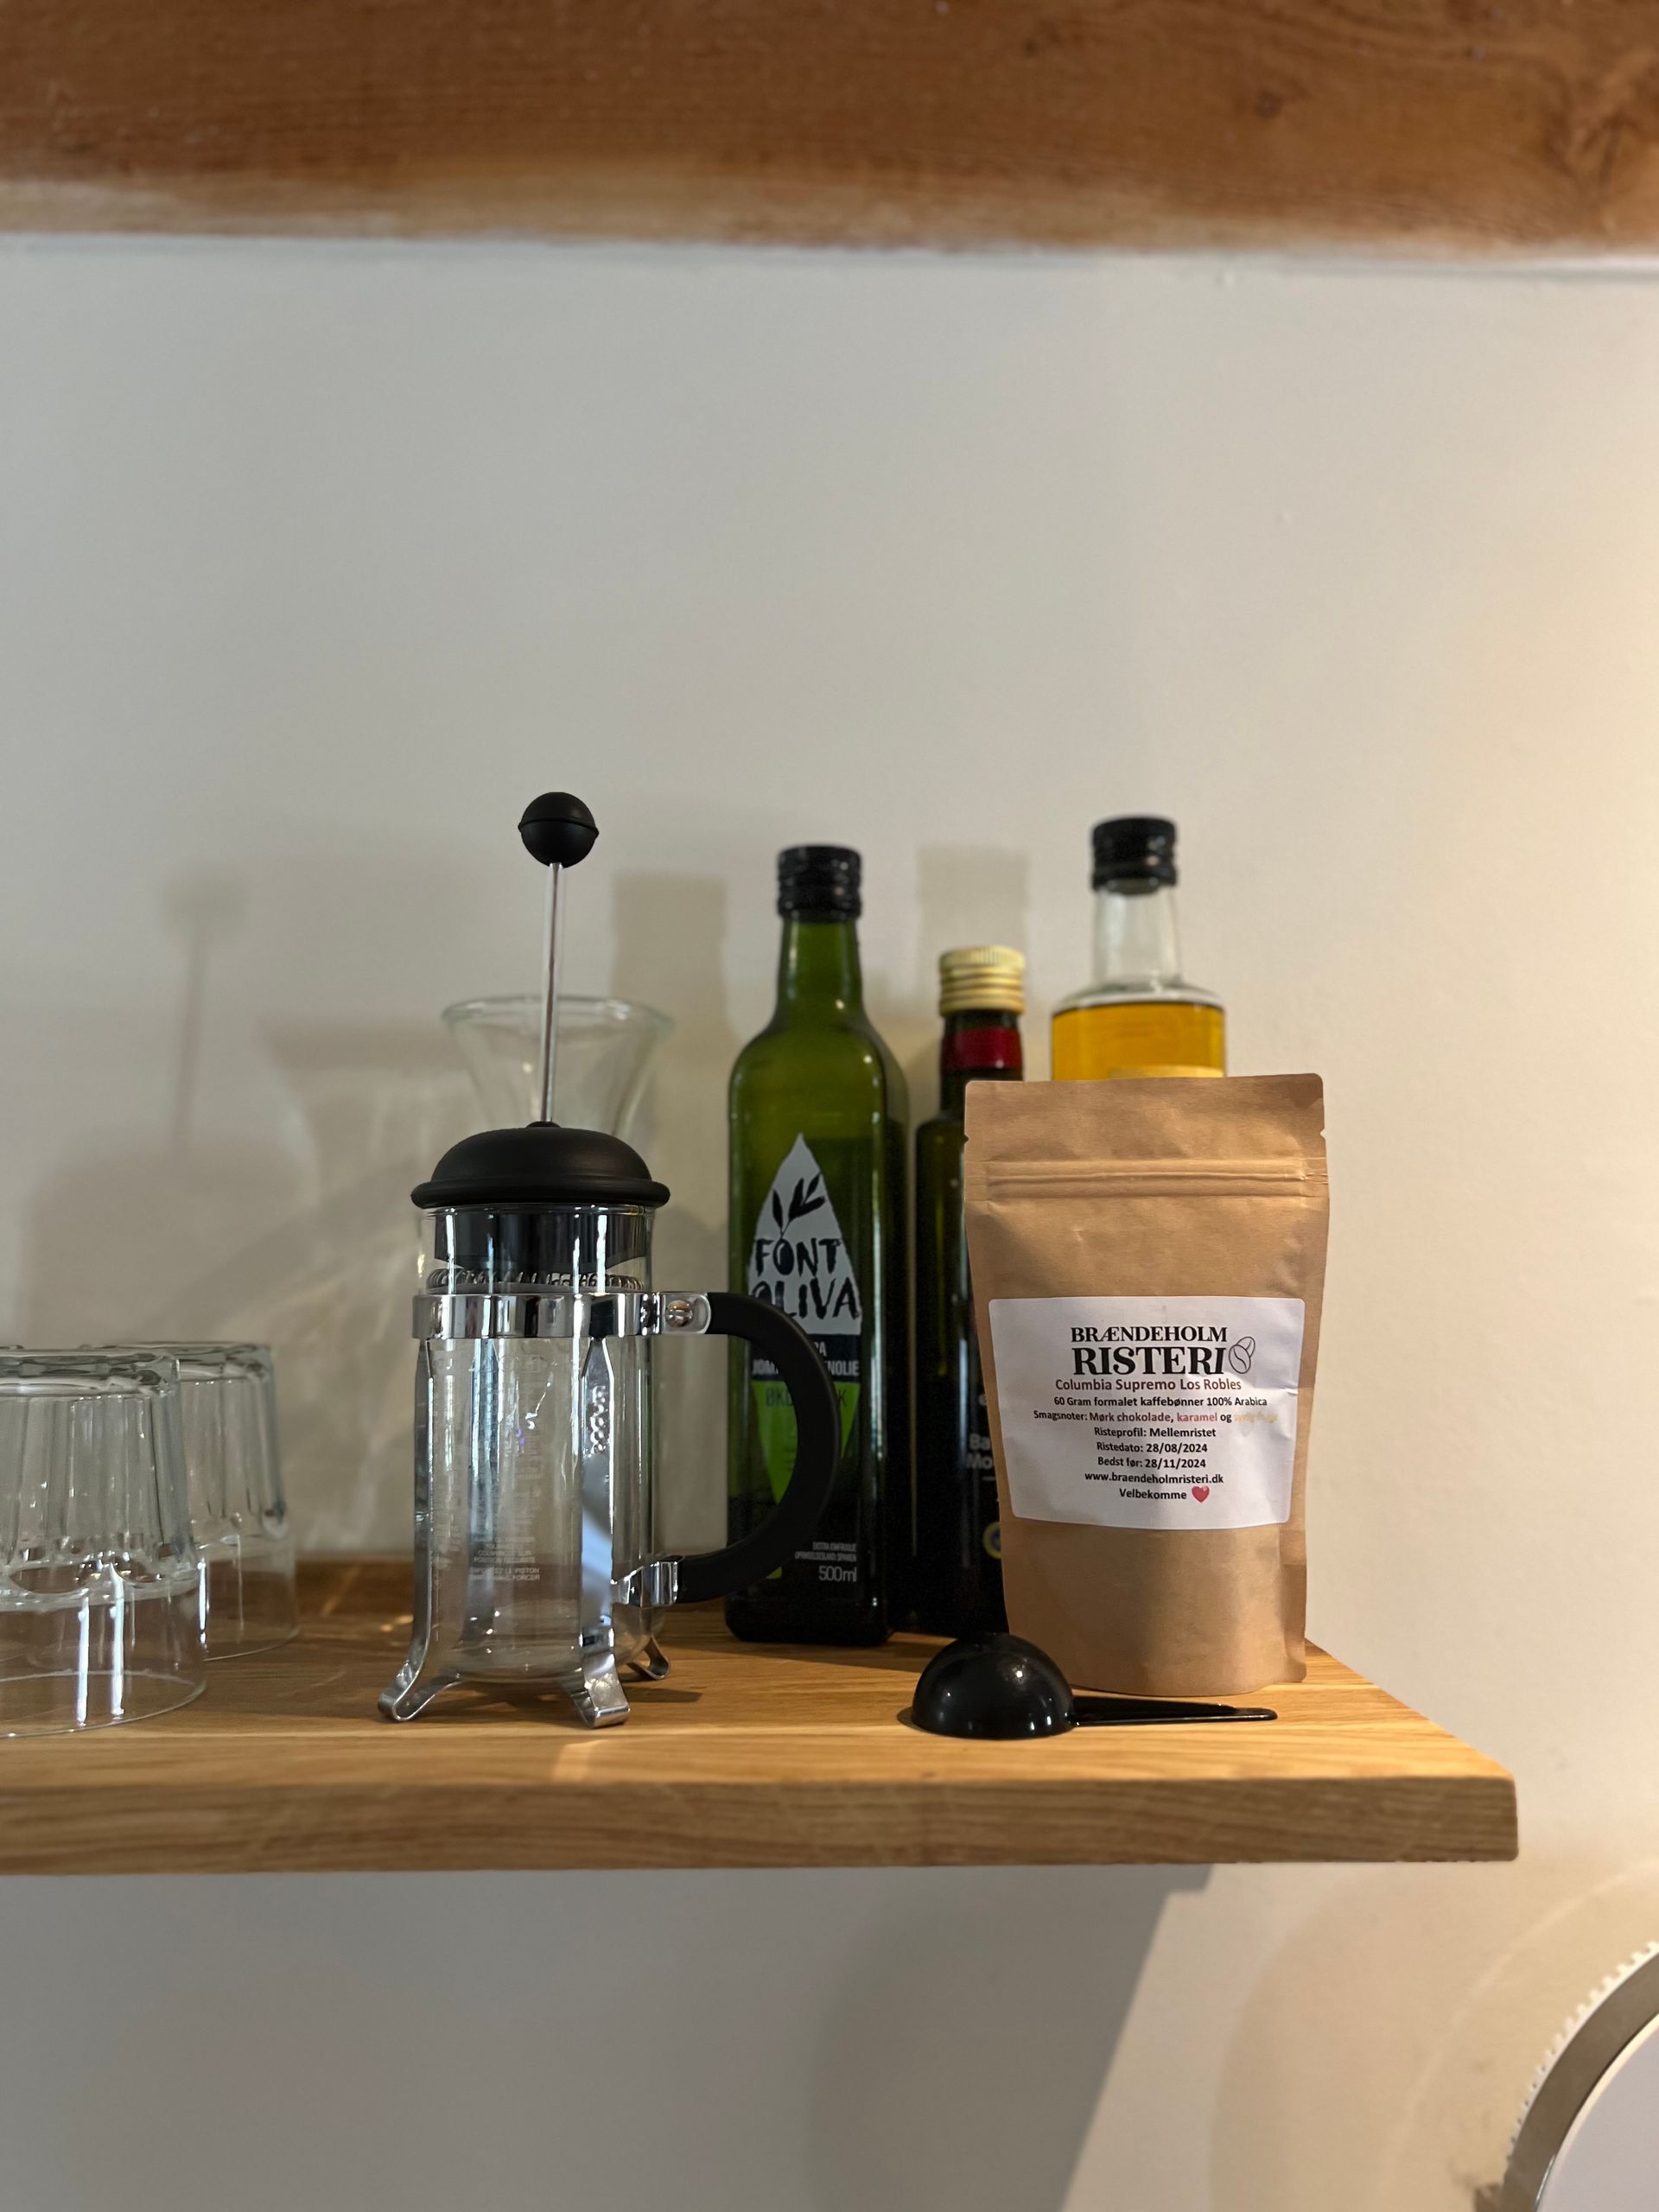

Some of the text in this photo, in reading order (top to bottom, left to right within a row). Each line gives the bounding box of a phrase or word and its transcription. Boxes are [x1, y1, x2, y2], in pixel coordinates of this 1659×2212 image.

[754, 1237, 842, 1277] FONT
[1071, 1326, 1228, 1343] BRÆNDEHOLM
[1071, 1346, 1226, 1376] RISTERI
[1055, 1378, 1242, 1393] Columbia Supremo Los Robles
[1053, 1395, 1268, 1408] 60 Gram formalet kaffebønner 100% Arabica
[1033, 1409, 1088, 1422] Smagsnoter:
[1090, 1412, 1115, 1422] Mørk
[1116, 1411, 1174, 1423] chokolade,
[1177, 1413, 1217, 1422] karamel
[1219, 1414, 1232, 1424] og
[1094, 1427, 1217, 1439] Risteprofil: Mellemristet
[1096, 1441, 1208, 1454] Ristedato: 28/08/2024
[1097, 1456, 1207, 1470] Bedst før: 28/11/2024
[1084, 1471, 1224, 1484] www.braendeholmristeri.dk
[1119, 1487, 1187, 1500] Velbekomme
[818, 1565, 857, 1583] 500ml
